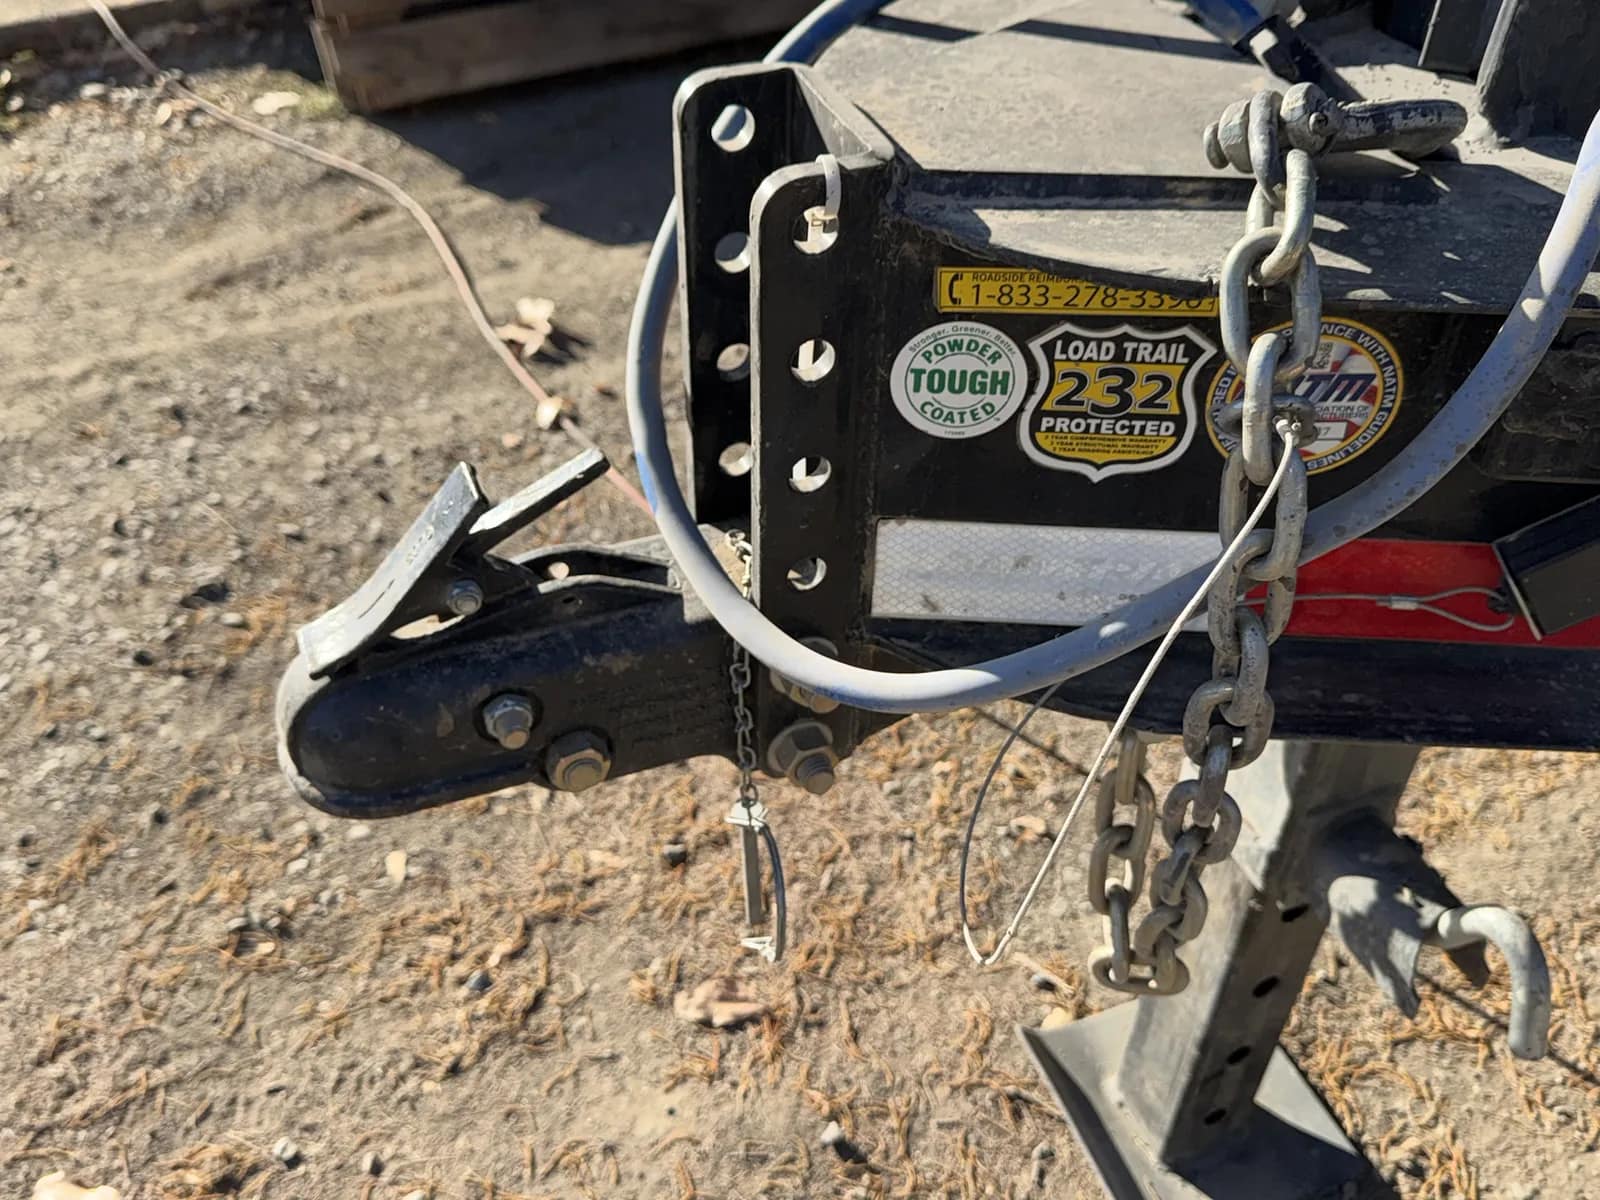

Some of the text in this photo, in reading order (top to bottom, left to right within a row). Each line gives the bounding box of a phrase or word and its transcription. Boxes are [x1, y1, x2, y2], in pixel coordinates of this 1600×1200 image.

[971, 272, 1025, 282] ROADSIDE
[922, 338, 1003, 364] POWDER
[1054, 340, 1190, 364] LOAD TRAIL
[910, 368, 1011, 396] TOUGH
[1052, 364, 1175, 417] 232
[920, 401, 996, 424] COATED
[1307, 332, 1397, 470] WITH NATM GUIDELINES
[1040, 417, 1175, 436] PROTECTED
